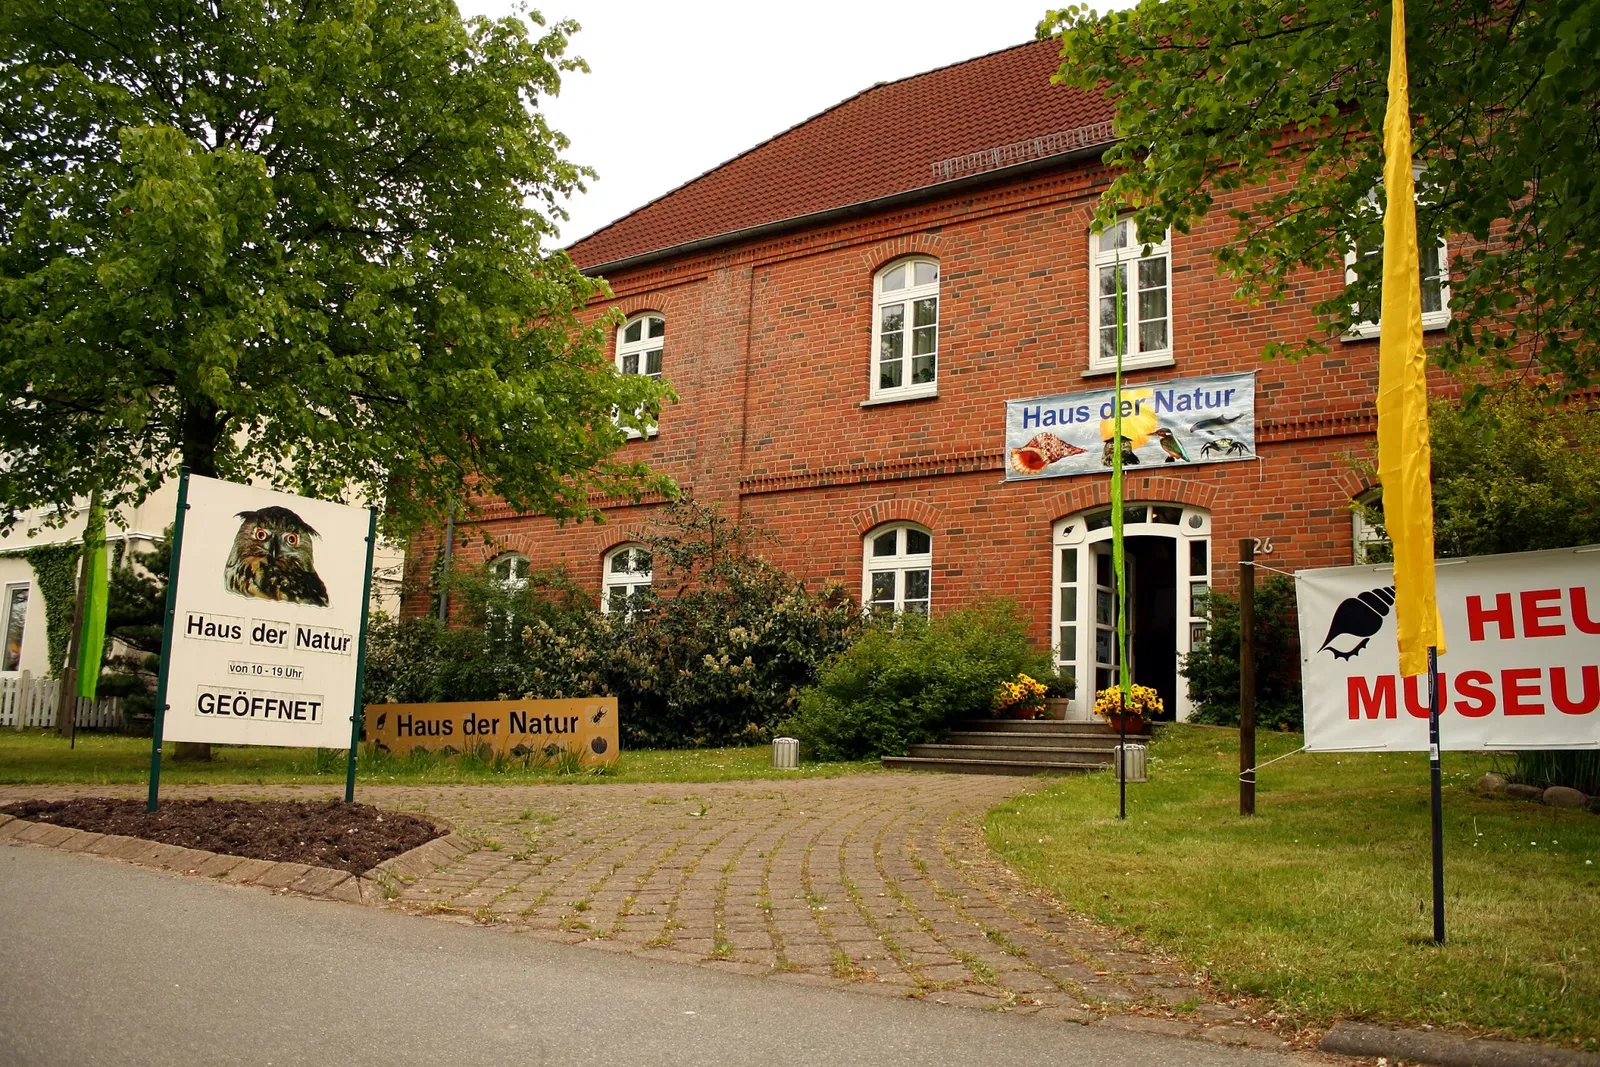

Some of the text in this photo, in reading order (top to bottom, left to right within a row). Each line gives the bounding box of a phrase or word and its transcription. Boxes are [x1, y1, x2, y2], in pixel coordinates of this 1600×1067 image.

[1023, 387, 1236, 429] Haus der Natur
[1253, 537, 1273, 554] 26
[187, 615, 350, 651] Haus der Natur
[229, 664, 248, 673] von
[251, 664, 263, 675] 10
[271, 667, 283, 677] 19
[285, 668, 303, 679] Uhr
[197, 691, 321, 721] GEÖFFNET
[397, 711, 579, 737] Haus der Natur
